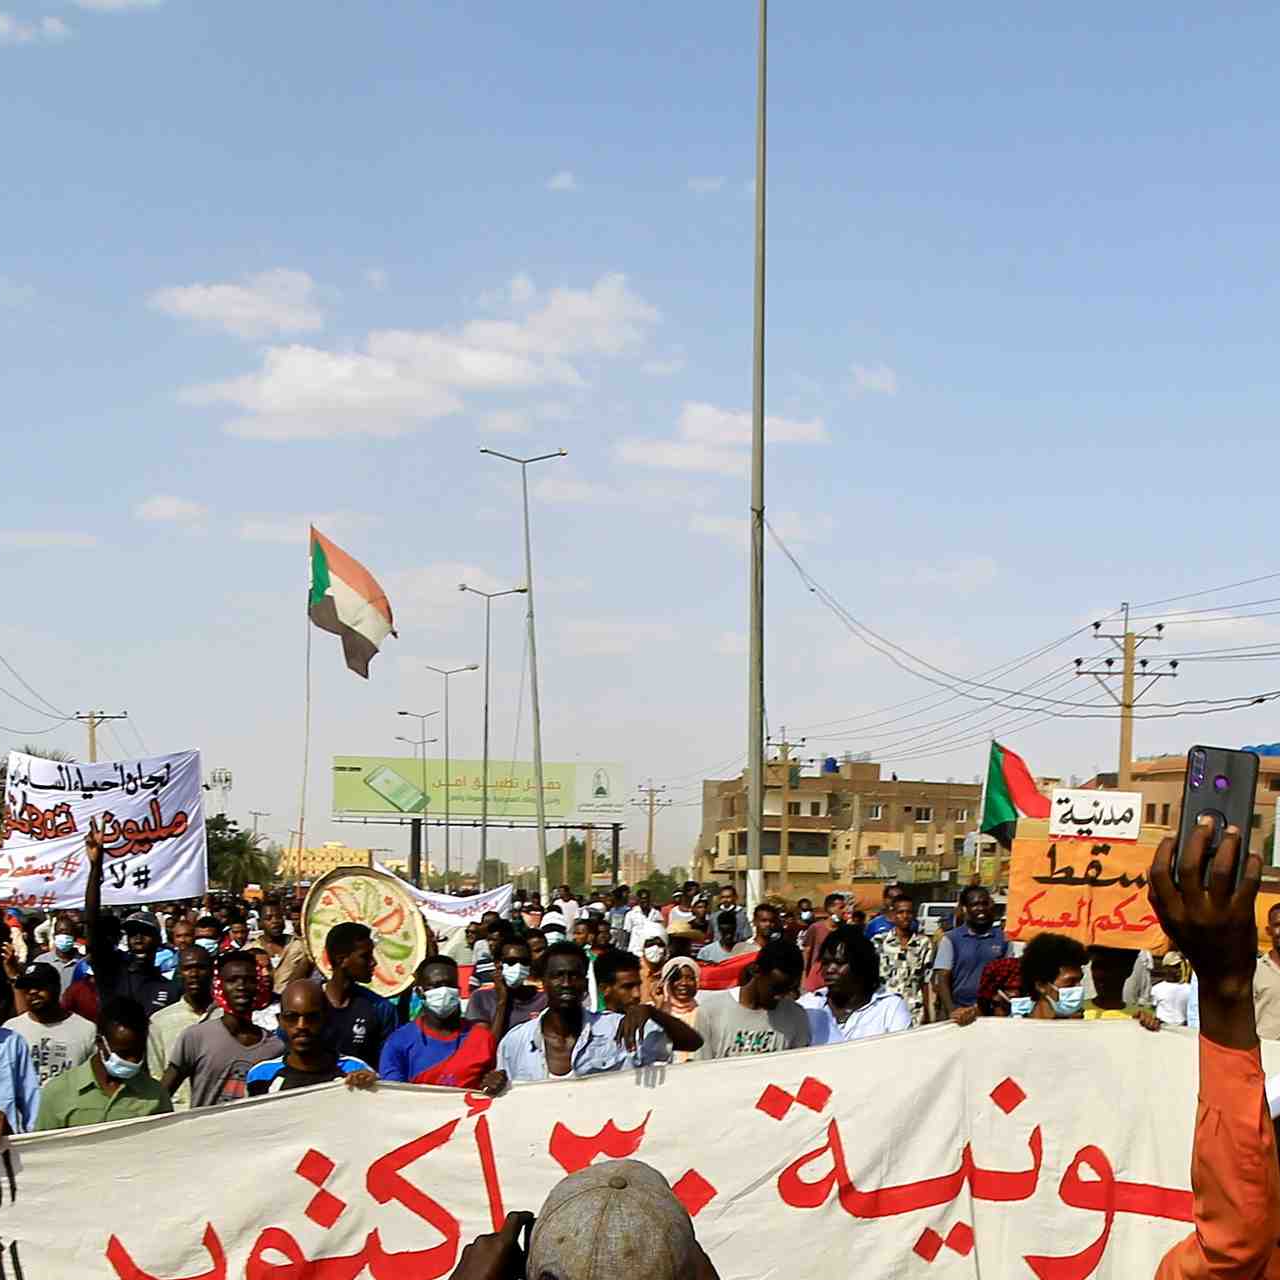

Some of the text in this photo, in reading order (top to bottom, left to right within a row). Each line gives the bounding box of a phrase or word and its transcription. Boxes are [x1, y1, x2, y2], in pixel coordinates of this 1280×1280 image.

[1055, 796, 1134, 836] مدنية
[1007, 890, 1161, 939] حكم العسكر
